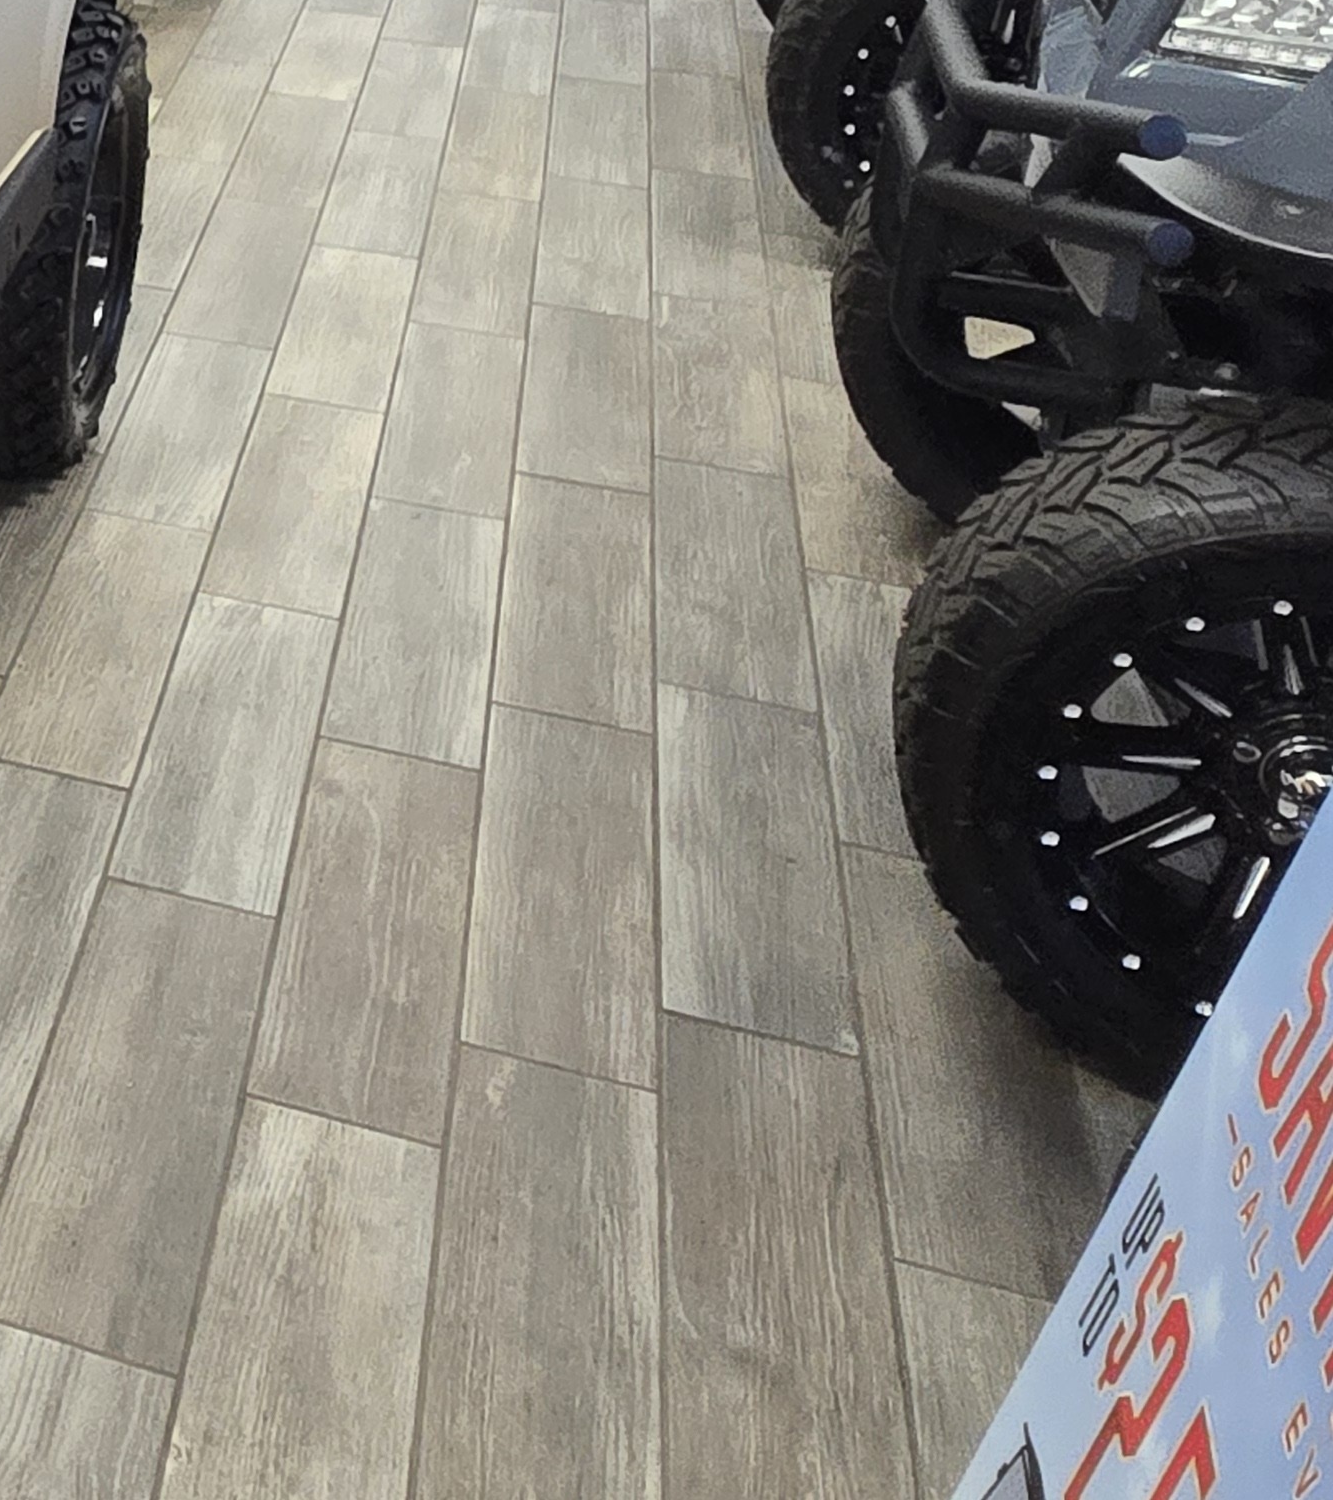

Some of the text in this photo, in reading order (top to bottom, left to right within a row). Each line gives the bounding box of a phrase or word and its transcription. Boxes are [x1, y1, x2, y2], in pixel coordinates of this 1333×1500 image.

[1121, 1172, 1166, 1270] UP
[1230, 1145, 1291, 1365] SALES
[1077, 1252, 1121, 1358] TO
